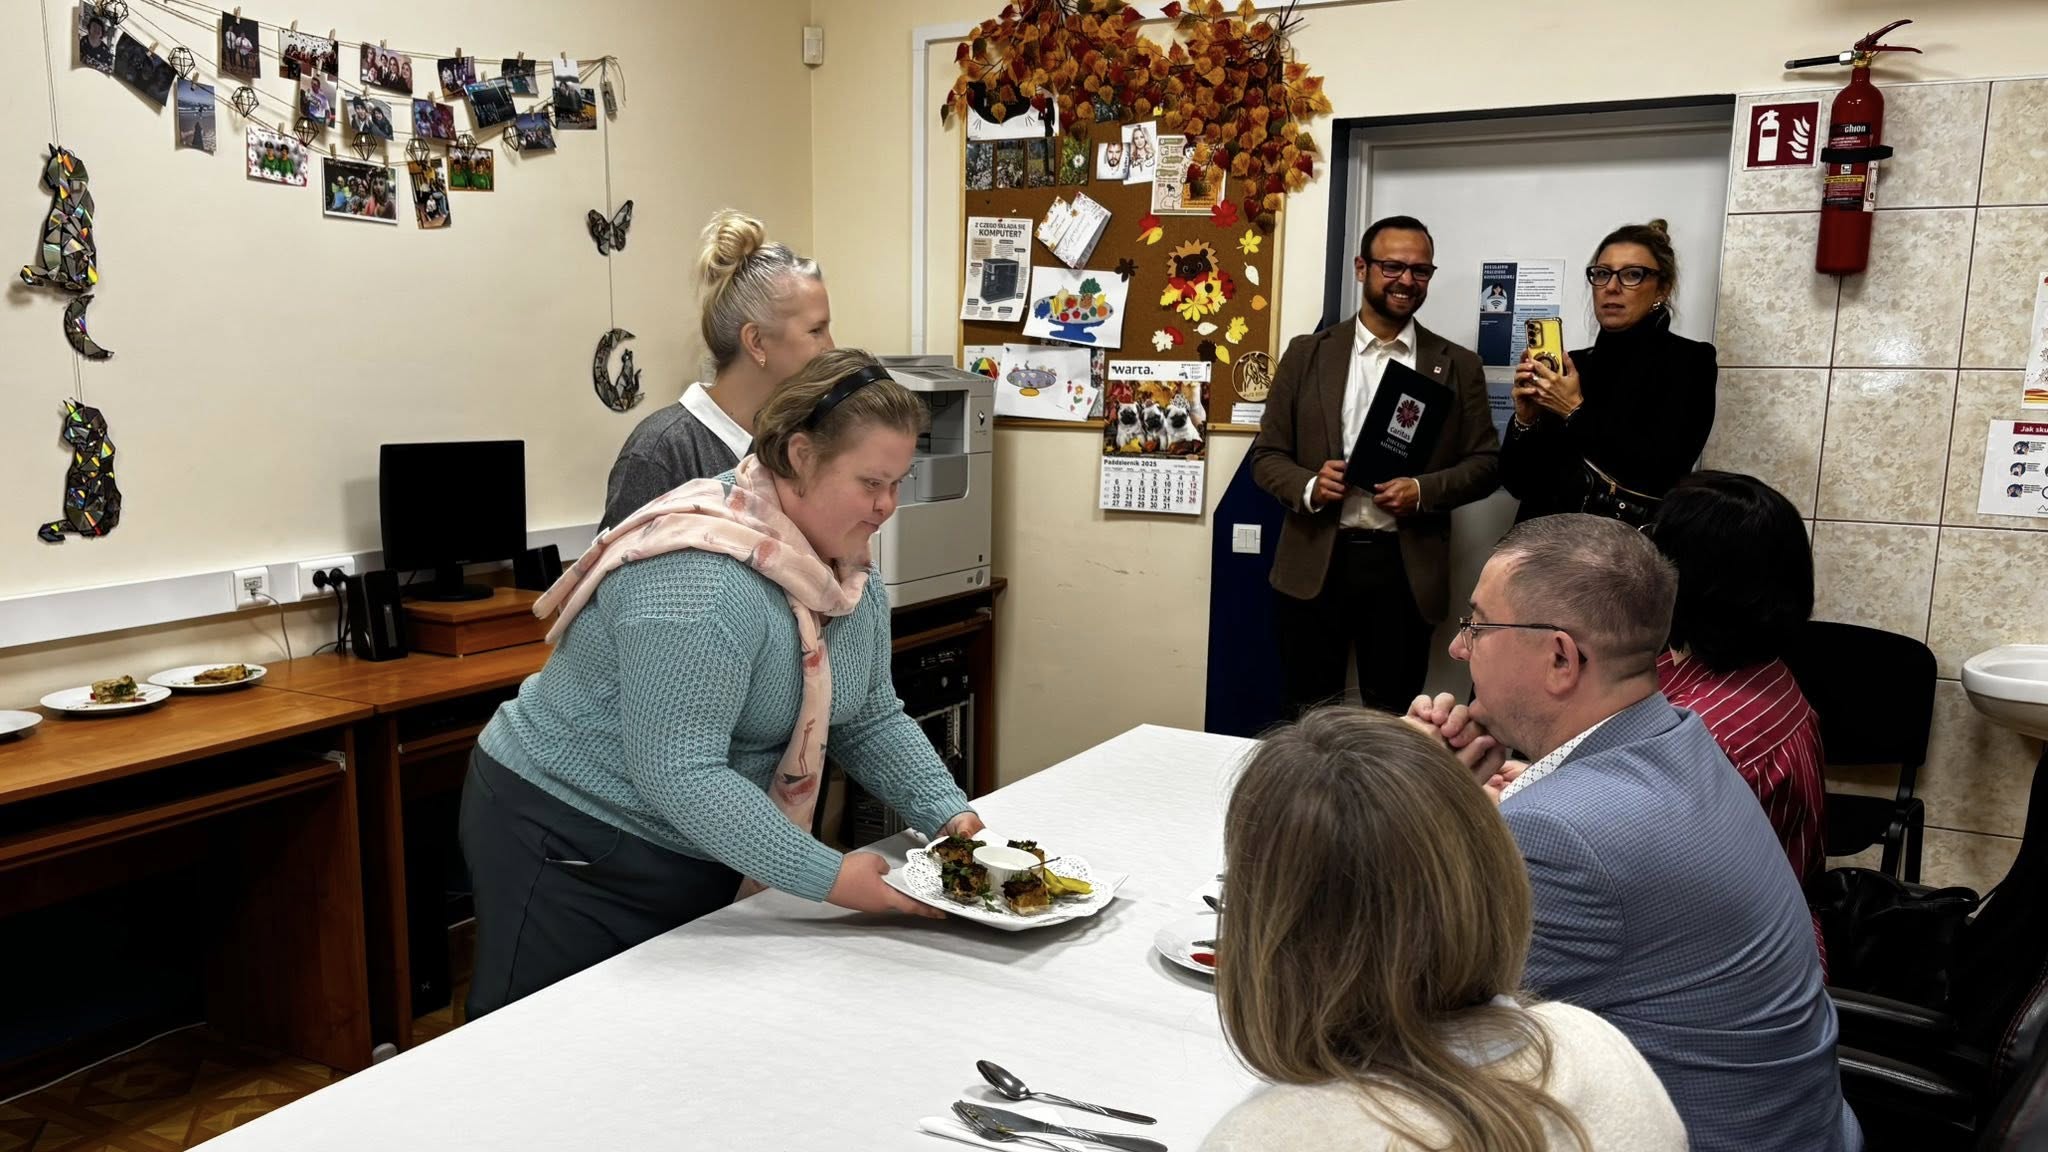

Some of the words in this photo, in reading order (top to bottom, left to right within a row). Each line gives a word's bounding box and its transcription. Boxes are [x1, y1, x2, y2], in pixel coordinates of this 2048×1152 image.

[979, 229, 1022, 238] KOMPUTER?
[1112, 366, 1154, 375] warta.
[1390, 427, 1411, 441] caritas
[1165, 473, 1170, 481] 3
[1150, 494, 1158, 502] 23
[1163, 502, 1171, 510] 31
